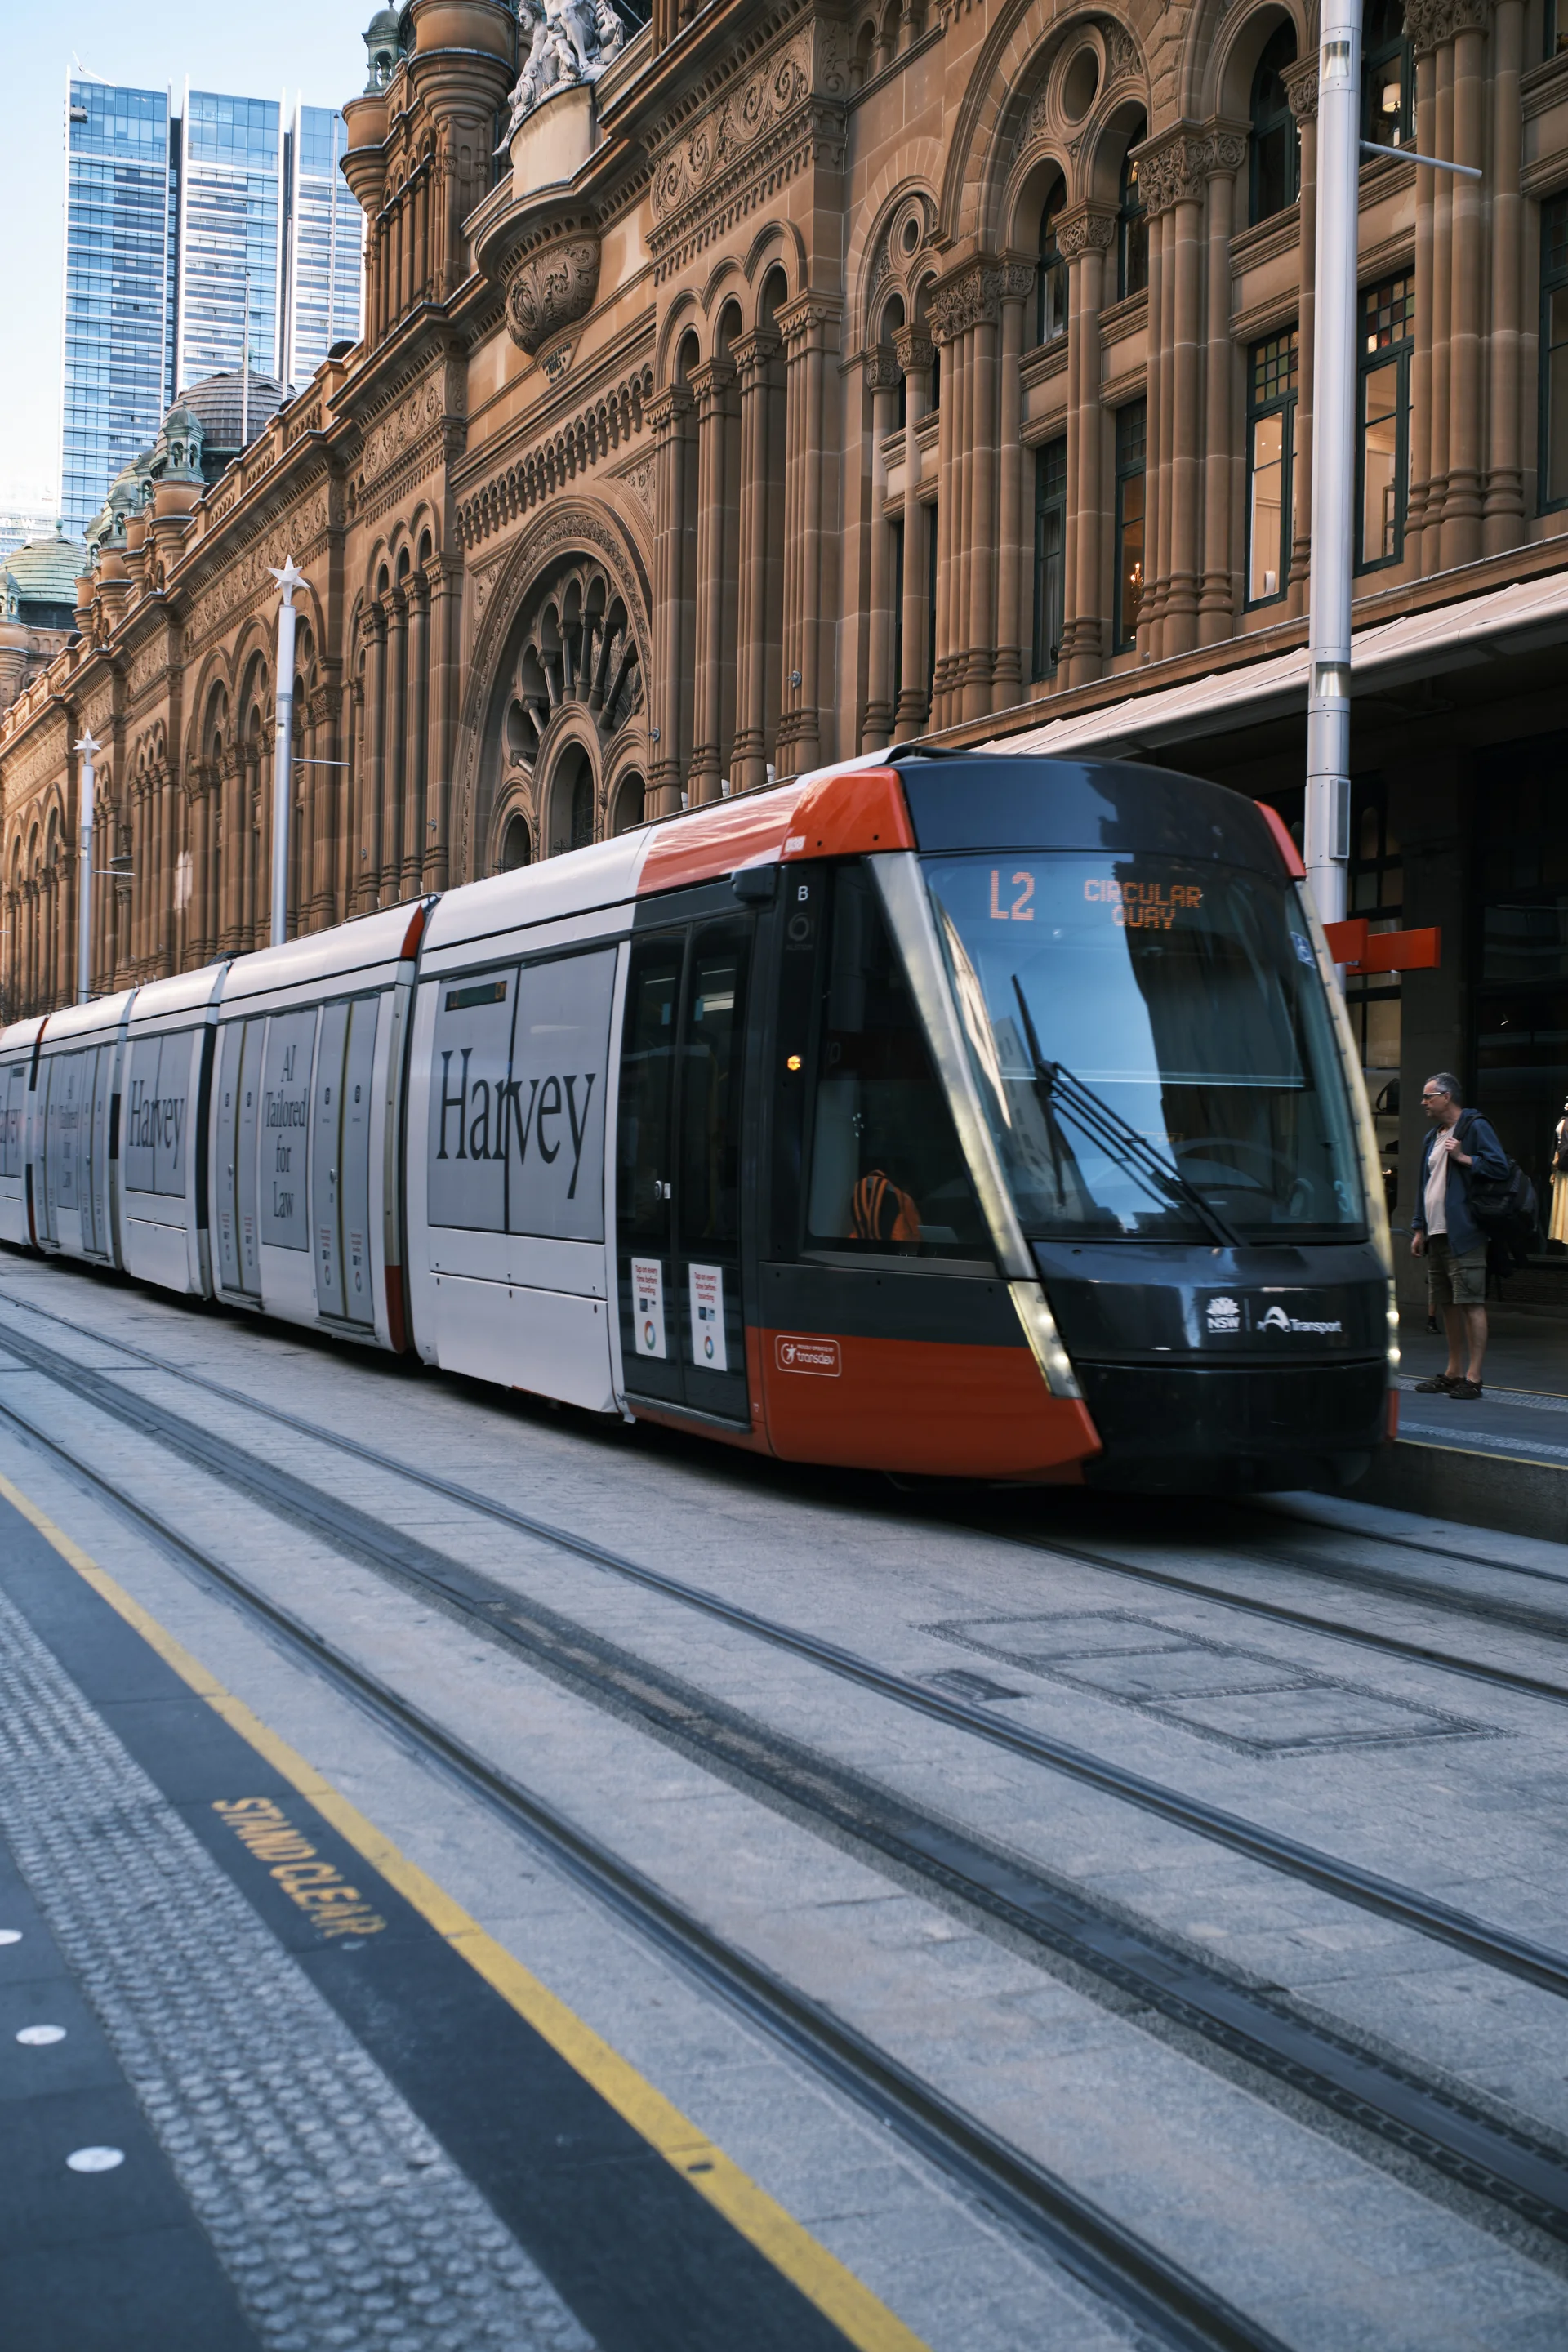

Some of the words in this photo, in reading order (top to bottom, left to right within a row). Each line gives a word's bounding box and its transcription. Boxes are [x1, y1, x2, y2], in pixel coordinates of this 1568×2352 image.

[797, 885, 809, 901] B
[990, 869, 1035, 921] L2
[1084, 879, 1202, 908] CIRCULAR
[1111, 904, 1176, 929] QUAY
[128, 1080, 185, 1169] Harvey
[265, 1088, 307, 1128] Tailored
[435, 1047, 597, 1200] Harvey
[275, 1134, 292, 1173] for
[272, 1181, 295, 1218] Law
[1206, 1316, 1241, 1329] NSW
[1290, 1318, 1343, 1334] Transport
[212, 1797, 317, 1861] STAND
[270, 1862, 387, 1938] CLEAR
